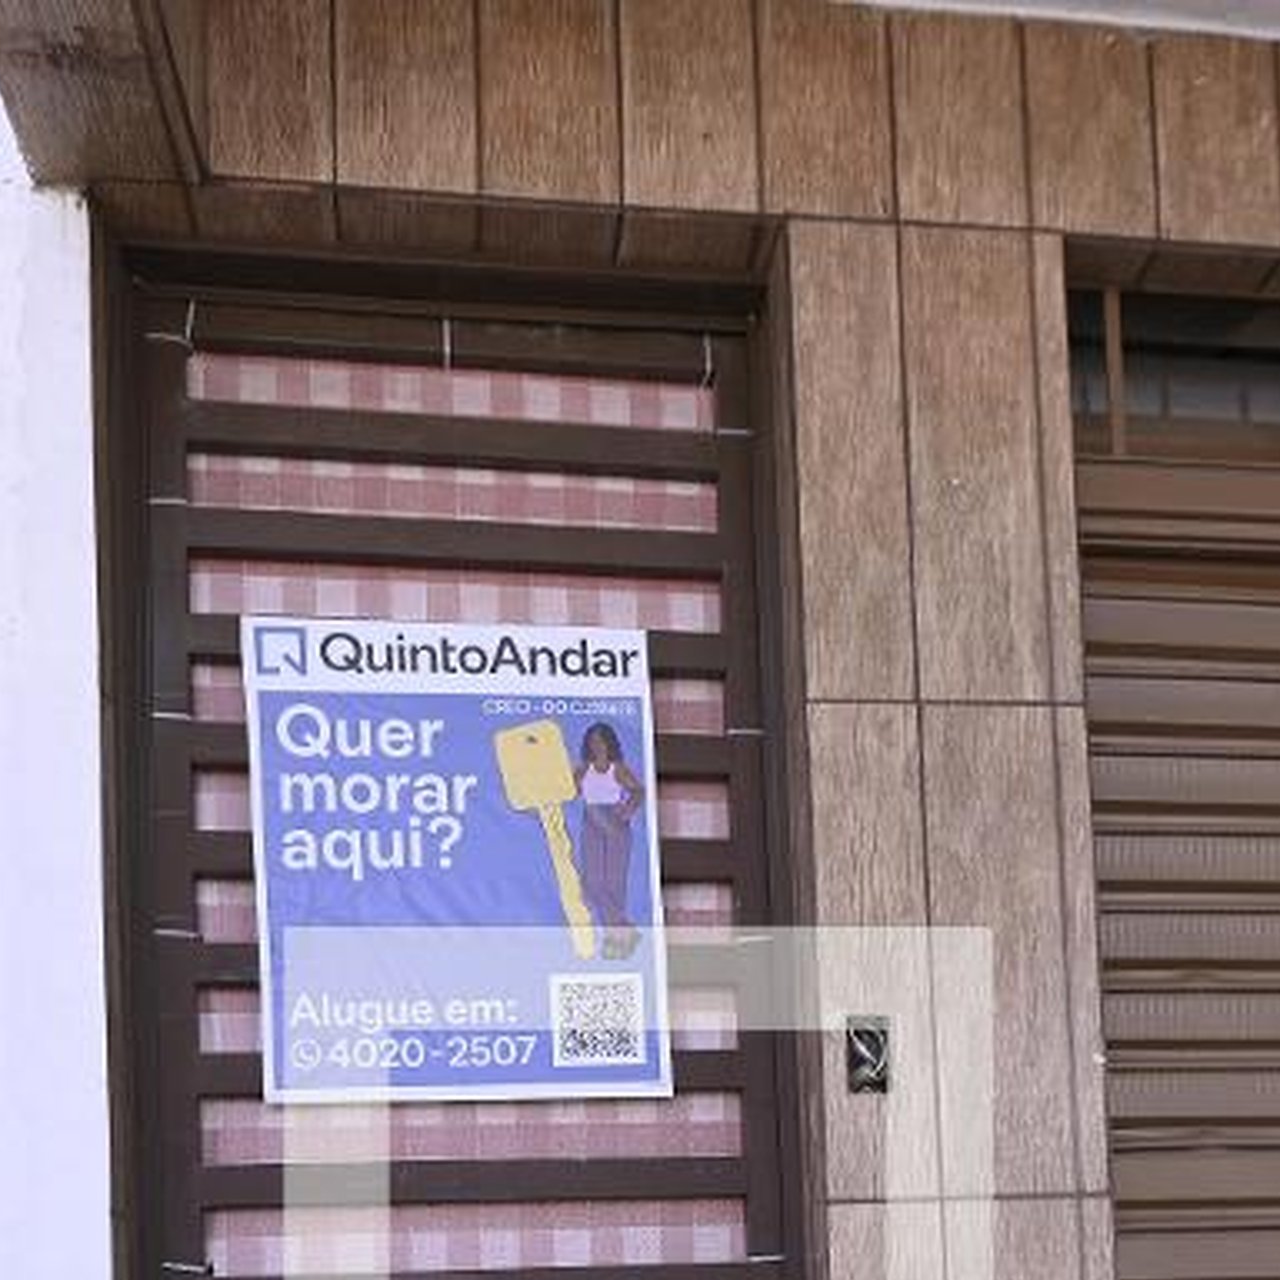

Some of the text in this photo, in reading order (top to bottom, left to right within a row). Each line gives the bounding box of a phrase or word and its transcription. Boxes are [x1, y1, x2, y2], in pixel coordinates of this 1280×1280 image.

[319, 632, 639, 679] QuintoAndar
[275, 703, 444, 760] Quer
[280, 769, 478, 815] morar
[281, 817, 465, 882] aqui?
[291, 991, 519, 1034] Alugue em:
